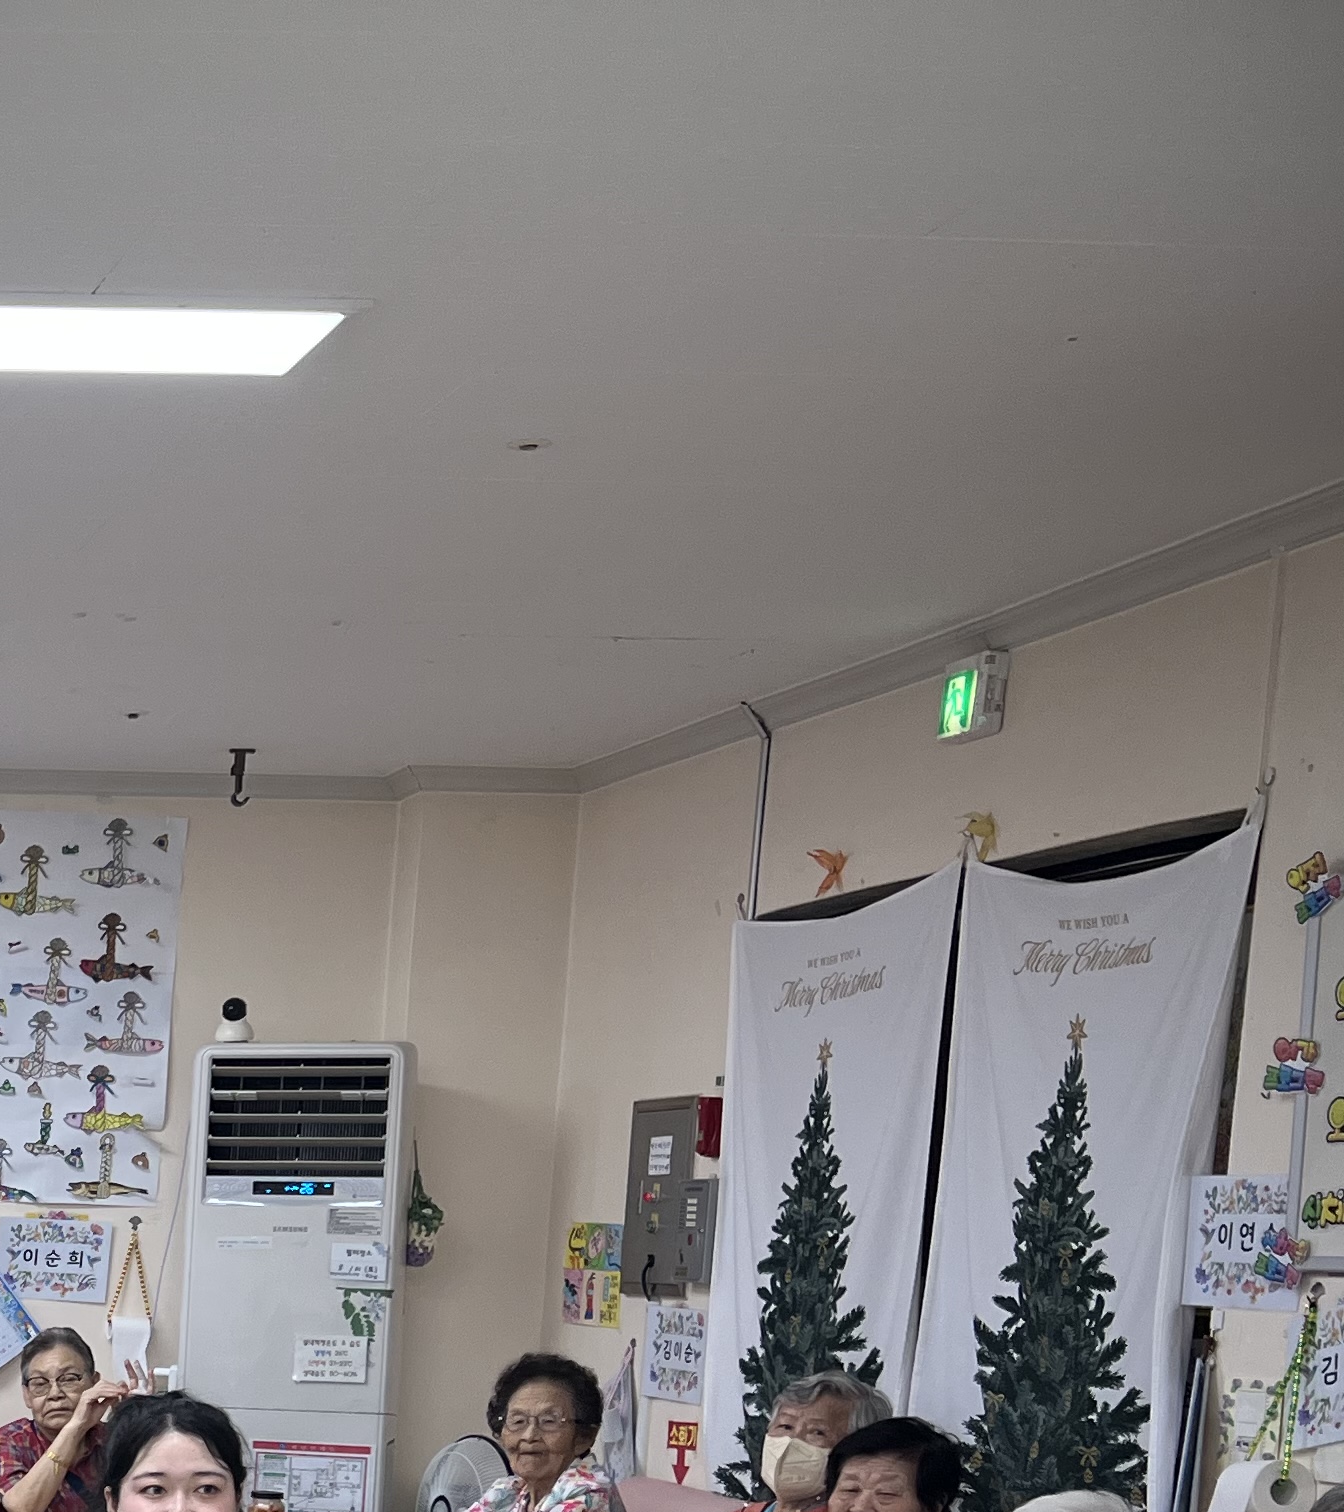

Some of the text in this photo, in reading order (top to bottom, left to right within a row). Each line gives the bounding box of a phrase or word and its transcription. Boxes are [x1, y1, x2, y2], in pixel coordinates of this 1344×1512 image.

[1058, 913, 1130, 930] WE WISH YOU A
[1012, 936, 1156, 987] Merry Christmas
[774, 965, 886, 1018] Merry Christmas
[23, 1248, 85, 1268] 이순희
[670, 1425, 698, 1448] 소화기
